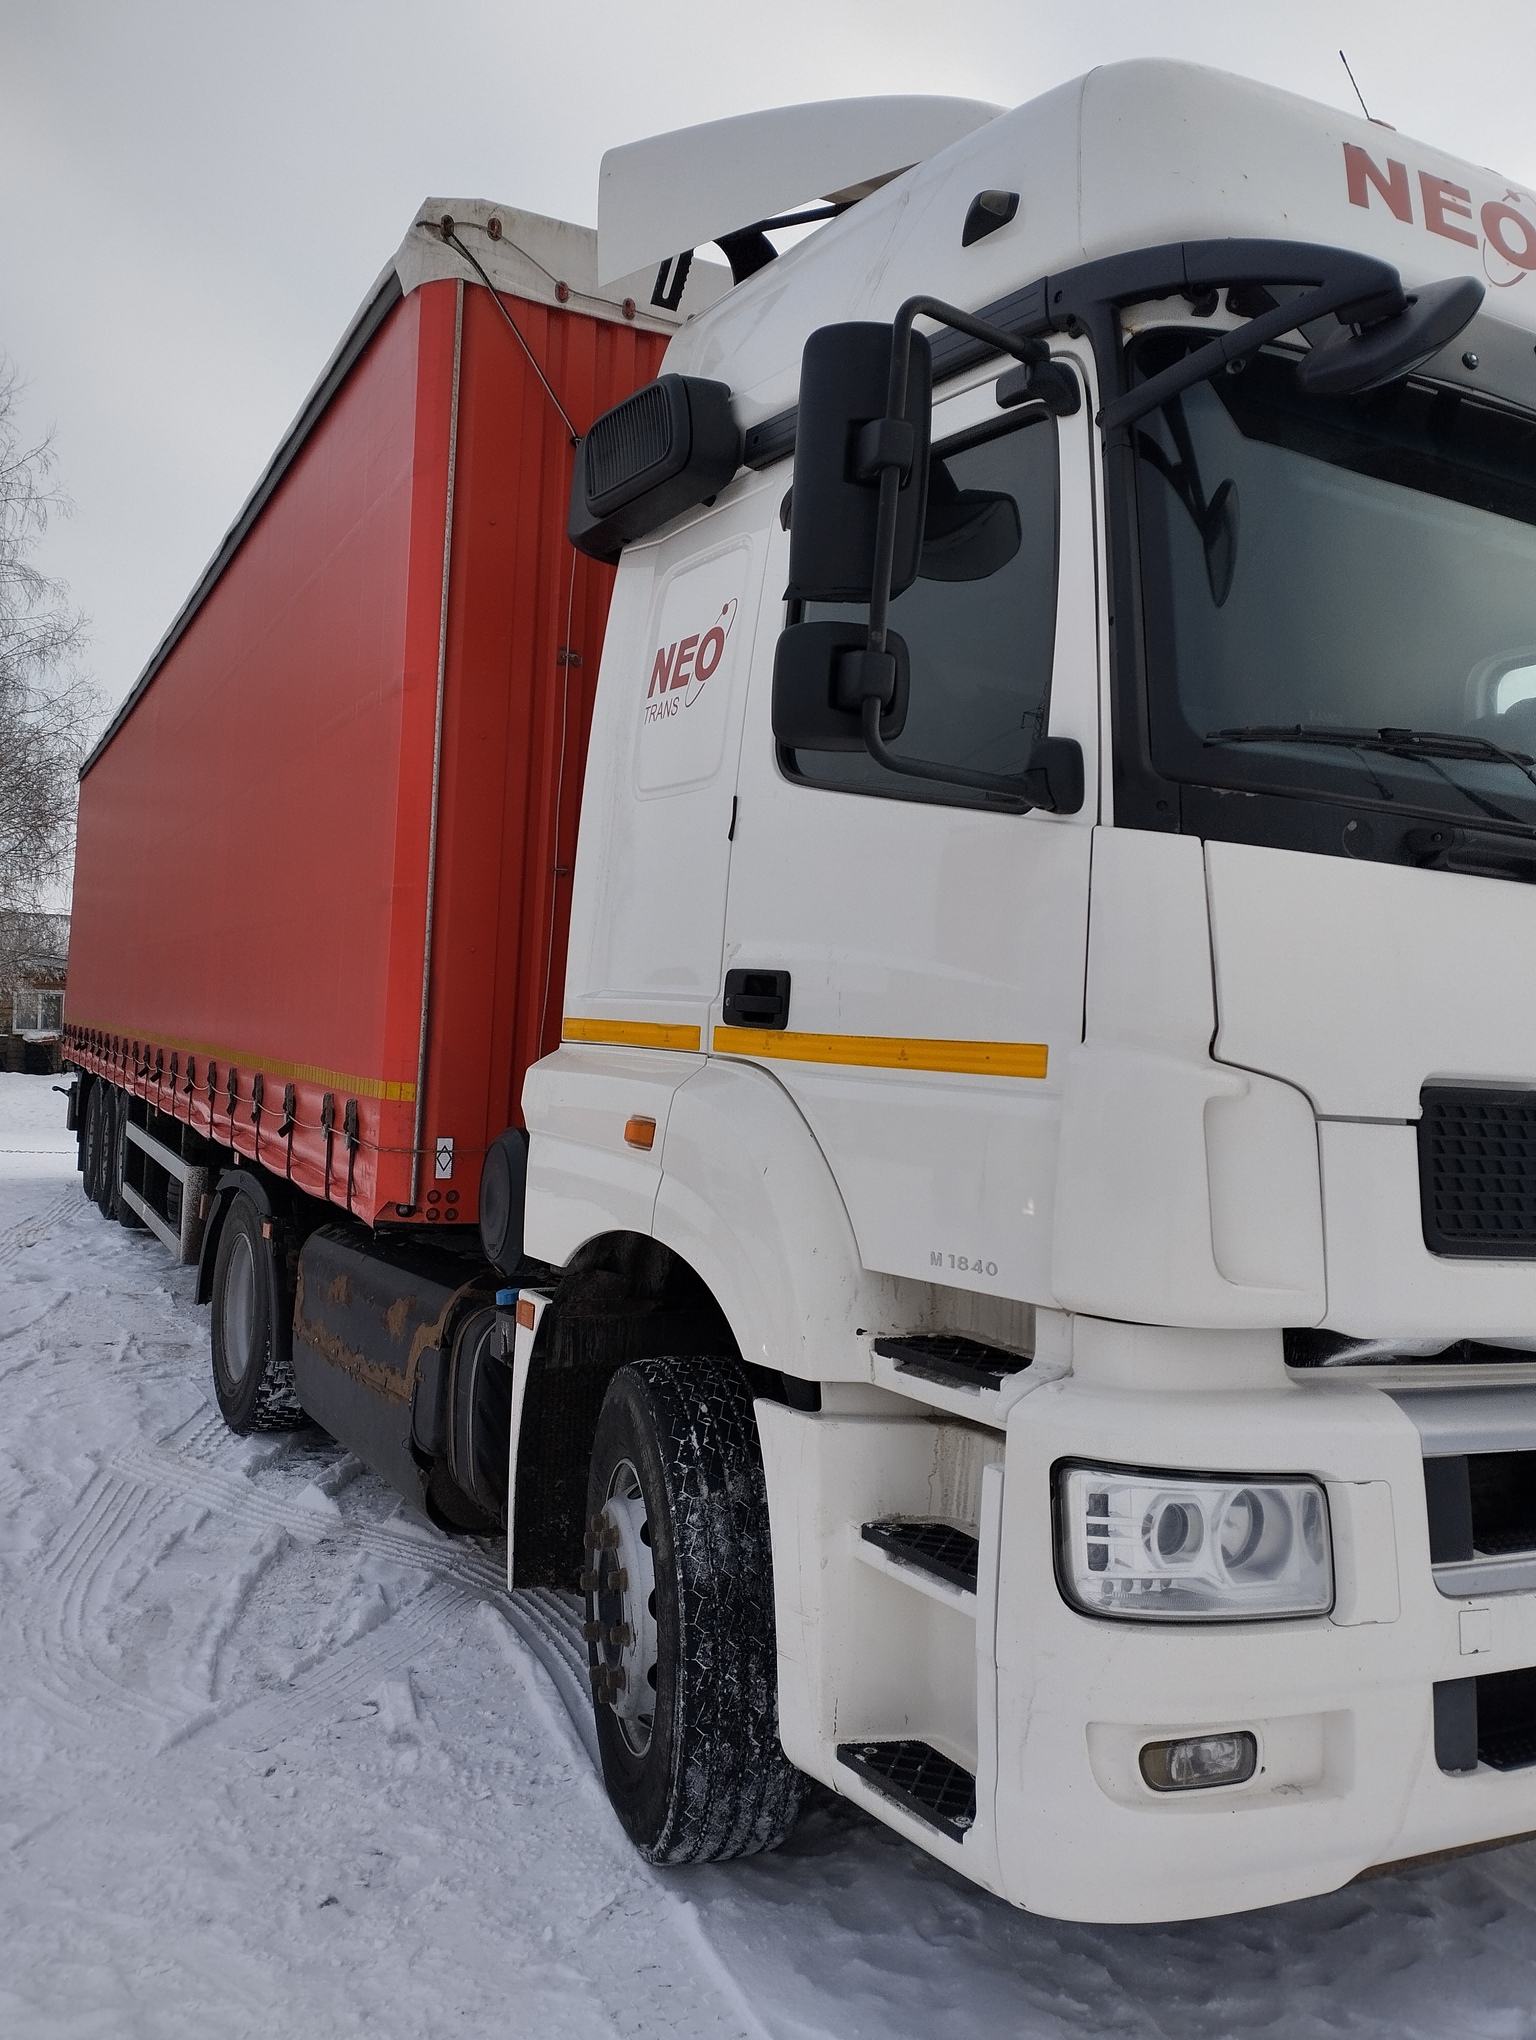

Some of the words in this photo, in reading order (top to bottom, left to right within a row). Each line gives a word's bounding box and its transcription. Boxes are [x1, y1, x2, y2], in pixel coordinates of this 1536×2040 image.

[1342, 141, 1536, 270] NEO
[646, 626, 725, 699] NEO
[643, 696, 680, 725] TRANS
[930, 1251, 943, 1267] M
[947, 1253, 999, 1277] 1840
